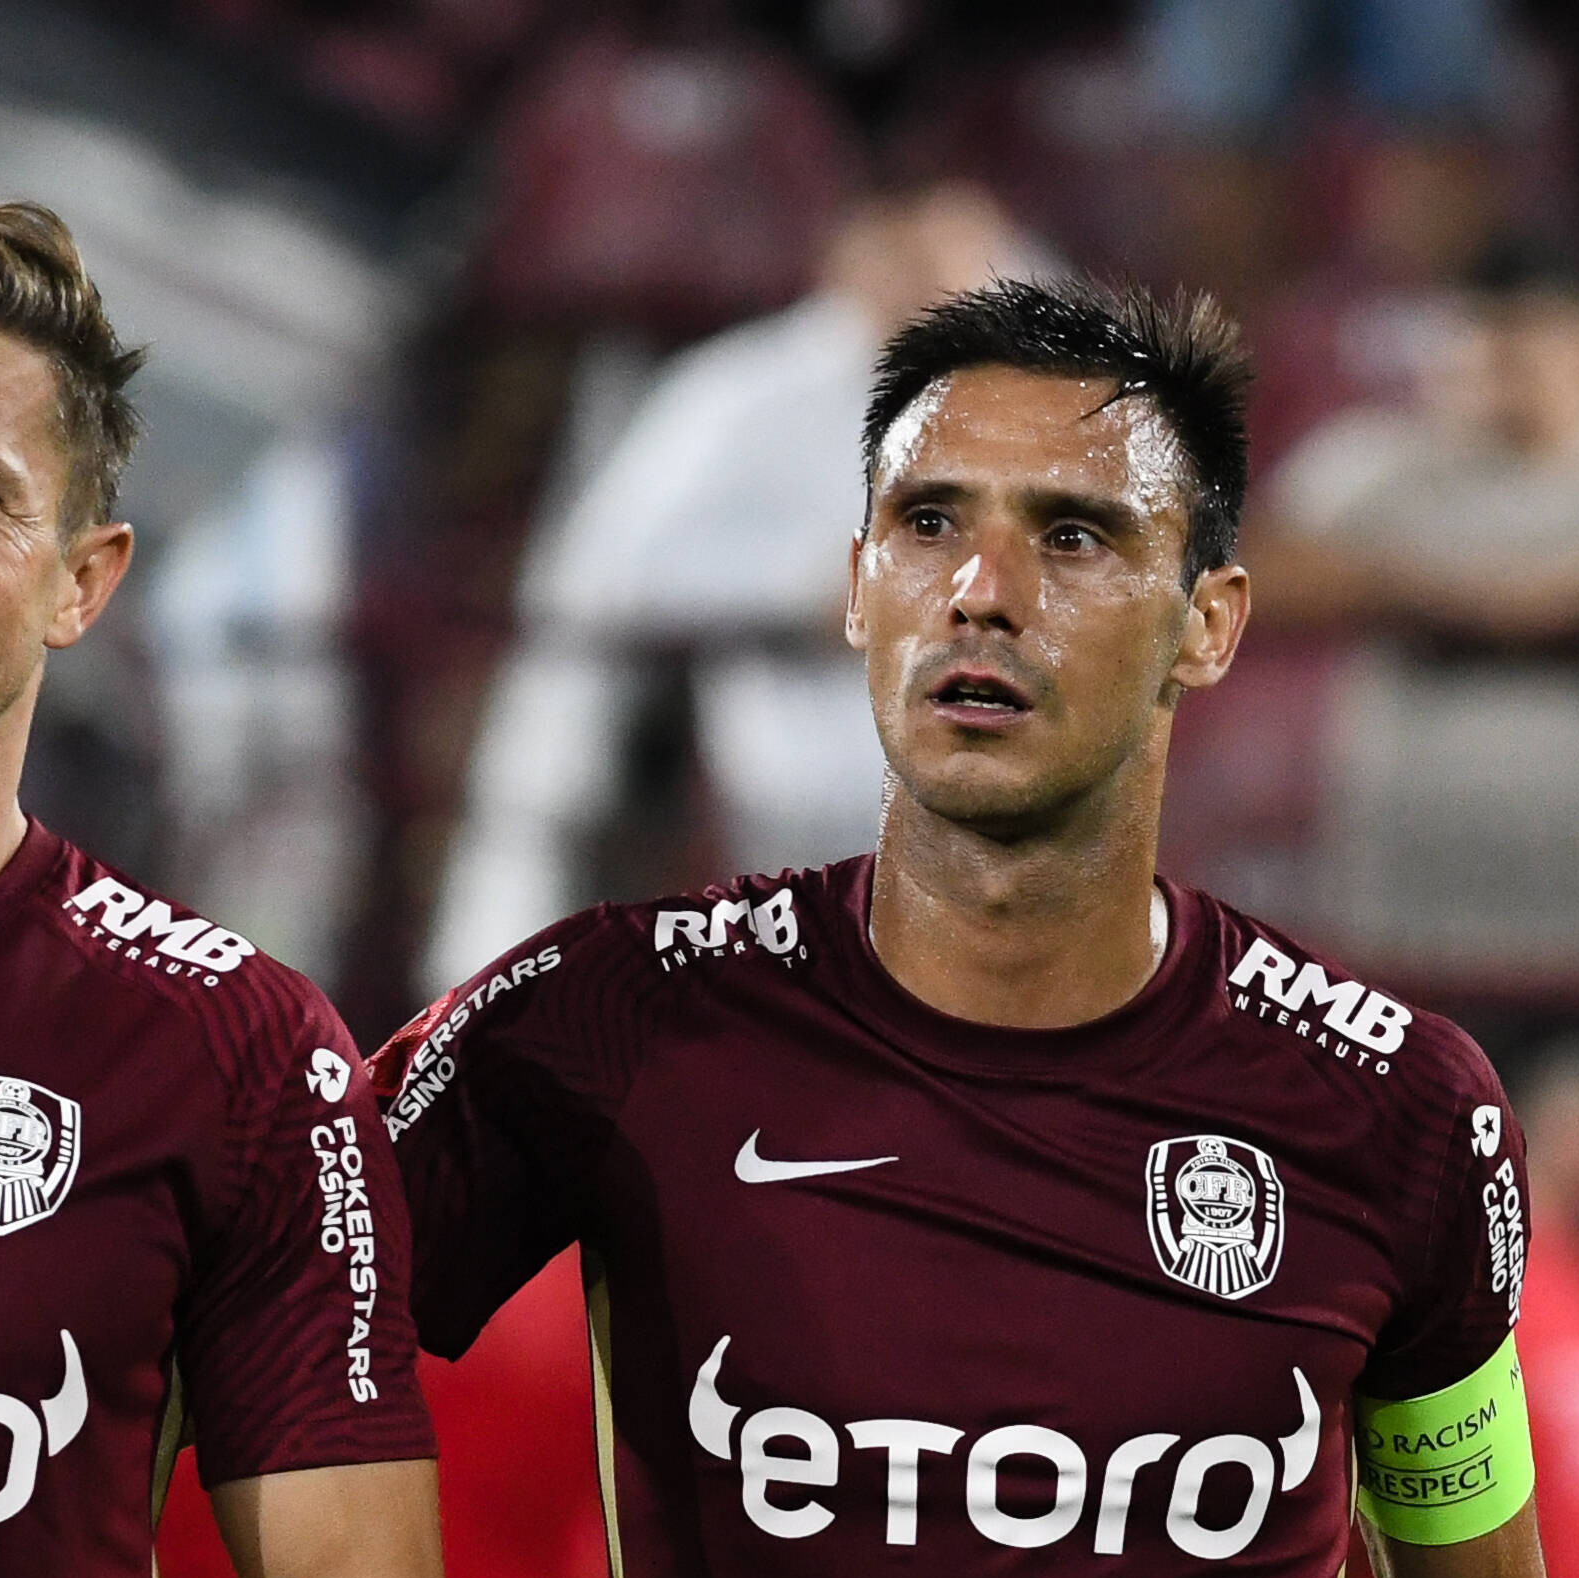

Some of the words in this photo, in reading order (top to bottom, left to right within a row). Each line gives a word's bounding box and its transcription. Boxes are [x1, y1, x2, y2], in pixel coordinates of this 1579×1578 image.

[62, 900, 219, 987] INTERAUTO
[72, 876, 256, 972] RMB
[655, 888, 798, 953] RMB
[661, 938, 807, 972] INTERTO
[1226, 986, 1390, 1075] NTERAUTO
[1228, 937, 1413, 1054] RMB
[385, 1056, 456, 1143] ASINO
[310, 1125, 345, 1253] CASINO
[1180, 1172, 1254, 1207] CFR
[333, 1116, 379, 1403] POKERSTARS
[1482, 1182, 1507, 1293] CASINO
[1495, 1157, 1524, 1327] POKERST
[1393, 1398, 1497, 1454] RACISM
